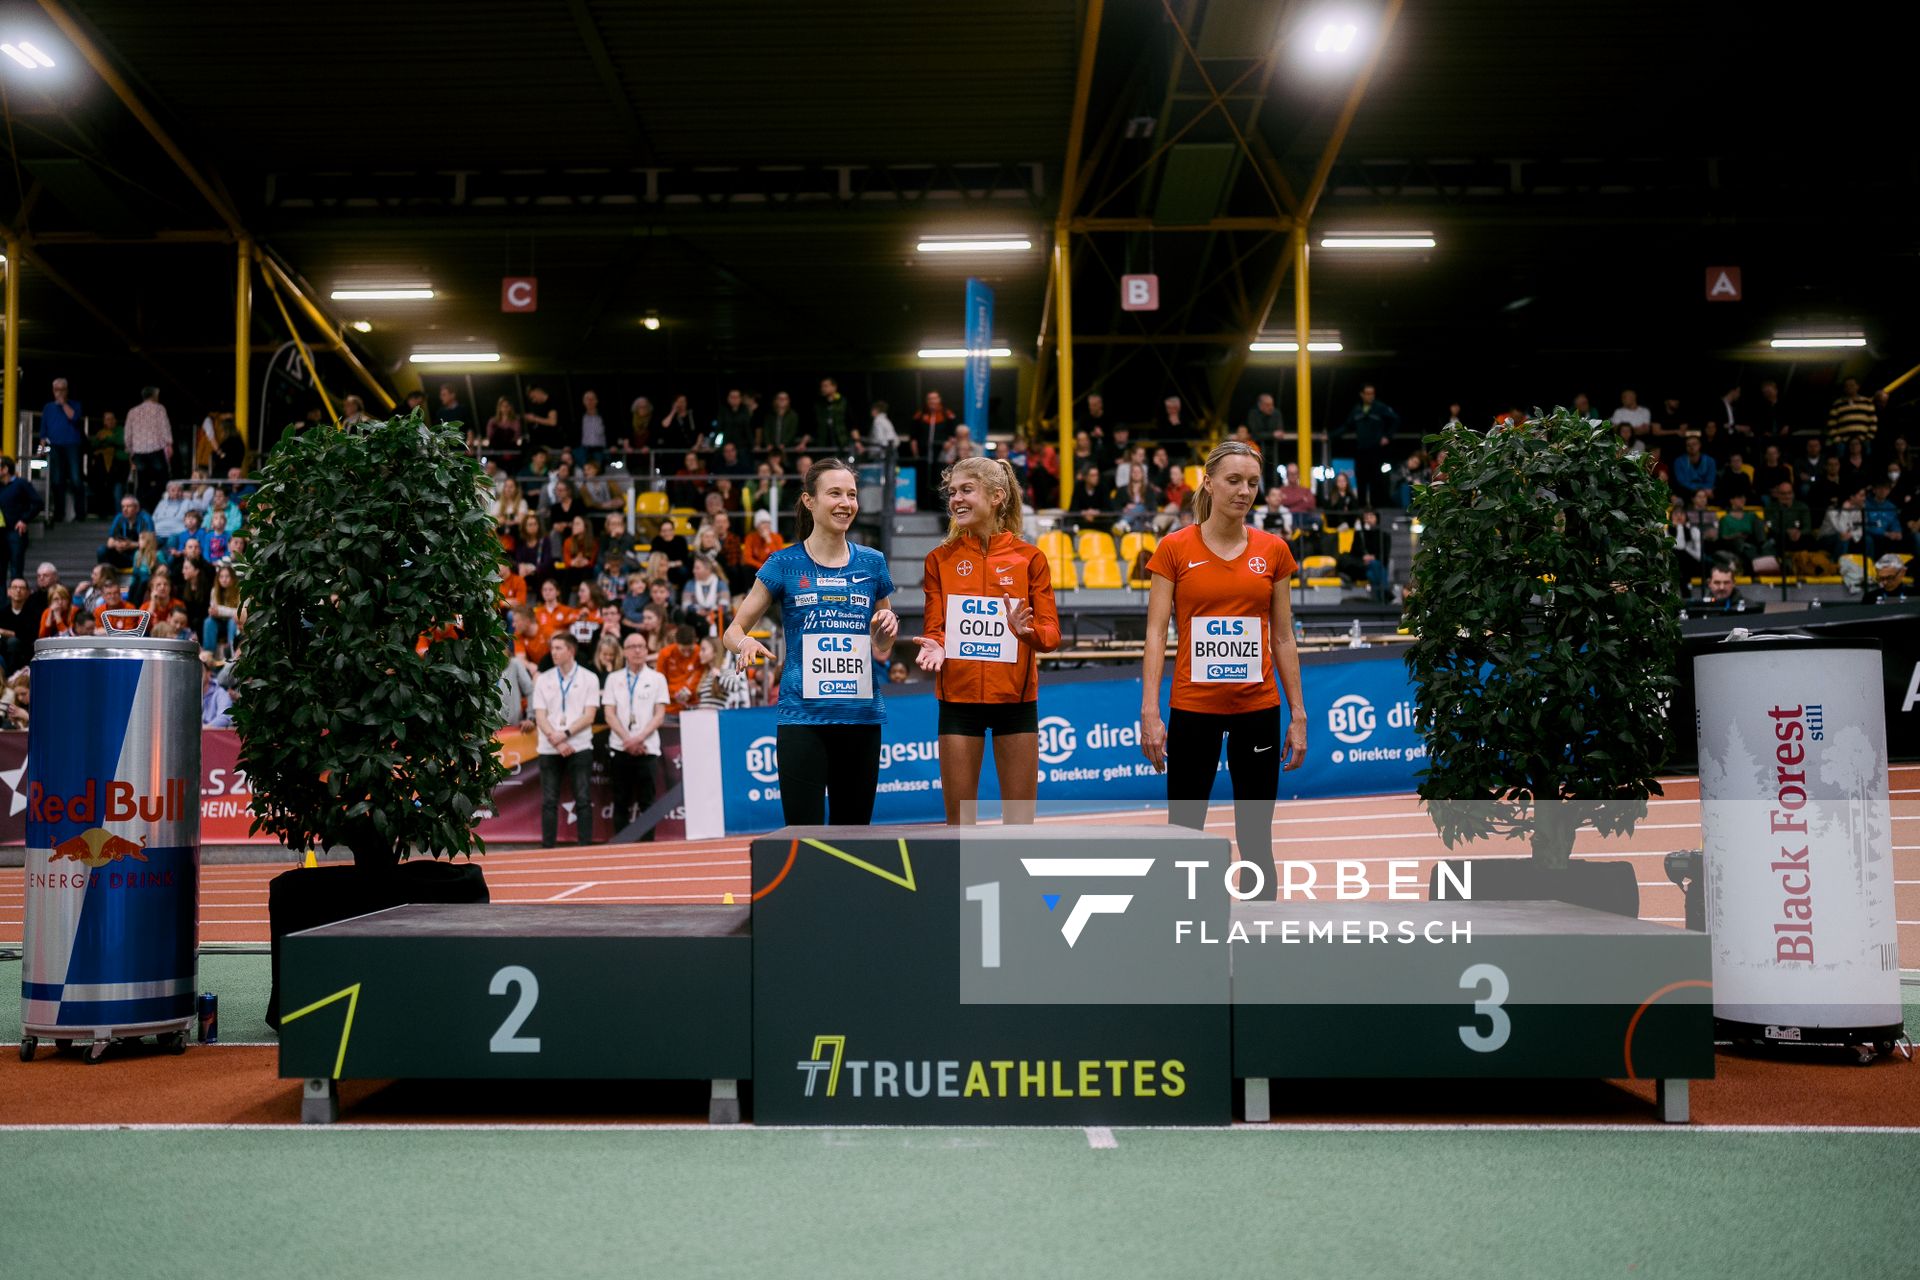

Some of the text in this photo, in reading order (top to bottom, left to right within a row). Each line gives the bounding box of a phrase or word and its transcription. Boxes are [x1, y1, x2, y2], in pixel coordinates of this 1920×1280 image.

[1128, 280, 1149, 304] B
[1711, 271, 1737, 296] A
[508, 282, 531, 306] C
[819, 609, 838, 618] LAV
[819, 619, 866, 630] TÜBINGEN
[960, 619, 1005, 637] GOLD
[976, 645, 999, 653] PLAN
[1195, 641, 1259, 658] BRONZE
[811, 658, 864, 674] SILBER
[1224, 666, 1247, 674] PLAN
[835, 682, 856, 690] PLAN
[1328, 706, 1376, 733] BIG
[1805, 703, 1824, 741] still
[1349, 747, 1402, 762] Direkter
[1050, 766, 1100, 782] Direkter
[1103, 764, 1132, 781] geht
[29, 778, 185, 824] Red Bull
[1767, 703, 1815, 965] Black Forest
[30, 871, 174, 889] ENERGY DRINK
[965, 881, 1000, 968] 1
[488, 965, 541, 1053] 2
[1458, 963, 1512, 1053] 3
